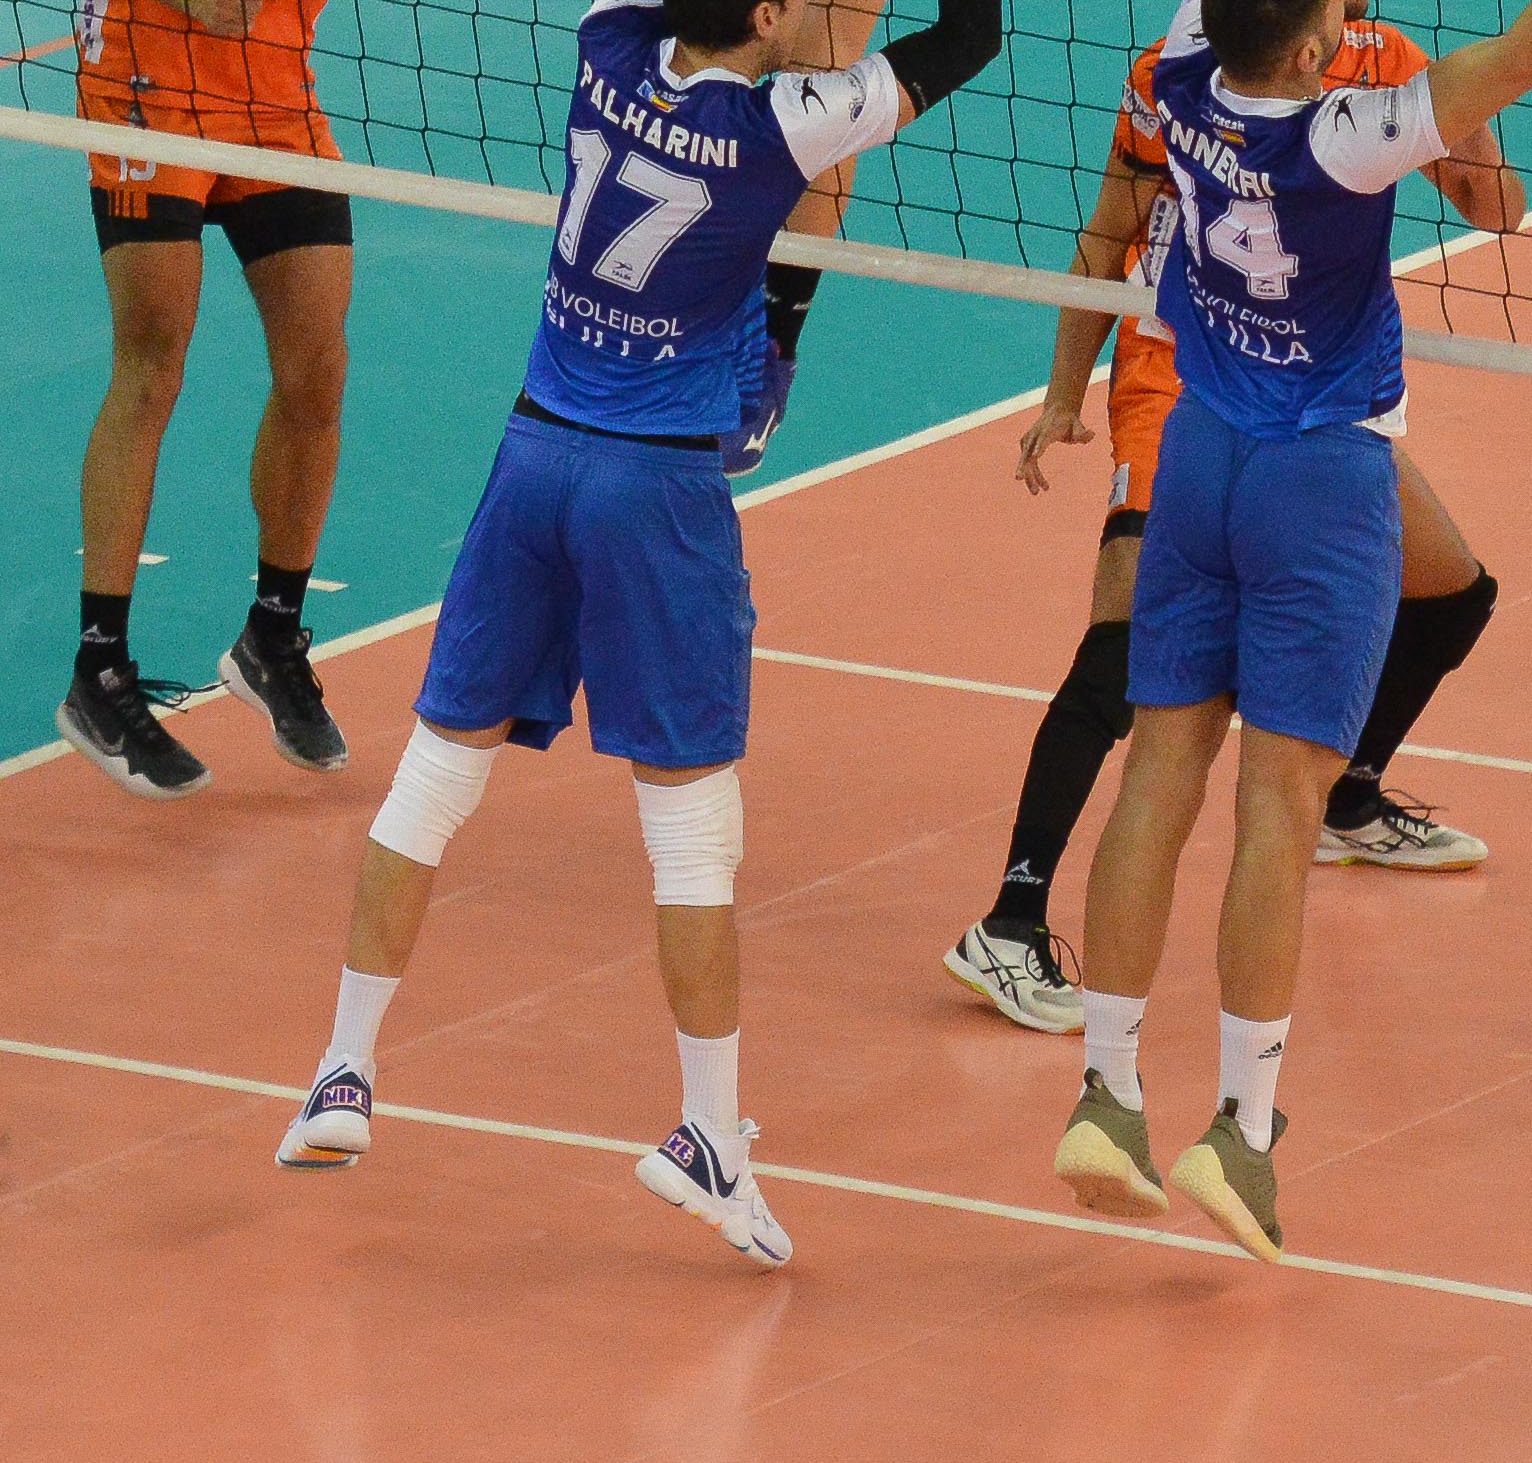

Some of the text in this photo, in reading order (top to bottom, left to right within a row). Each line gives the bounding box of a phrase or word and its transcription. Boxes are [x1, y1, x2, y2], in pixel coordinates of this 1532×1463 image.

[579, 59, 738, 169] PALHARINI
[557, 127, 713, 293] 17
[561, 286, 685, 338] VOLEIBOL
